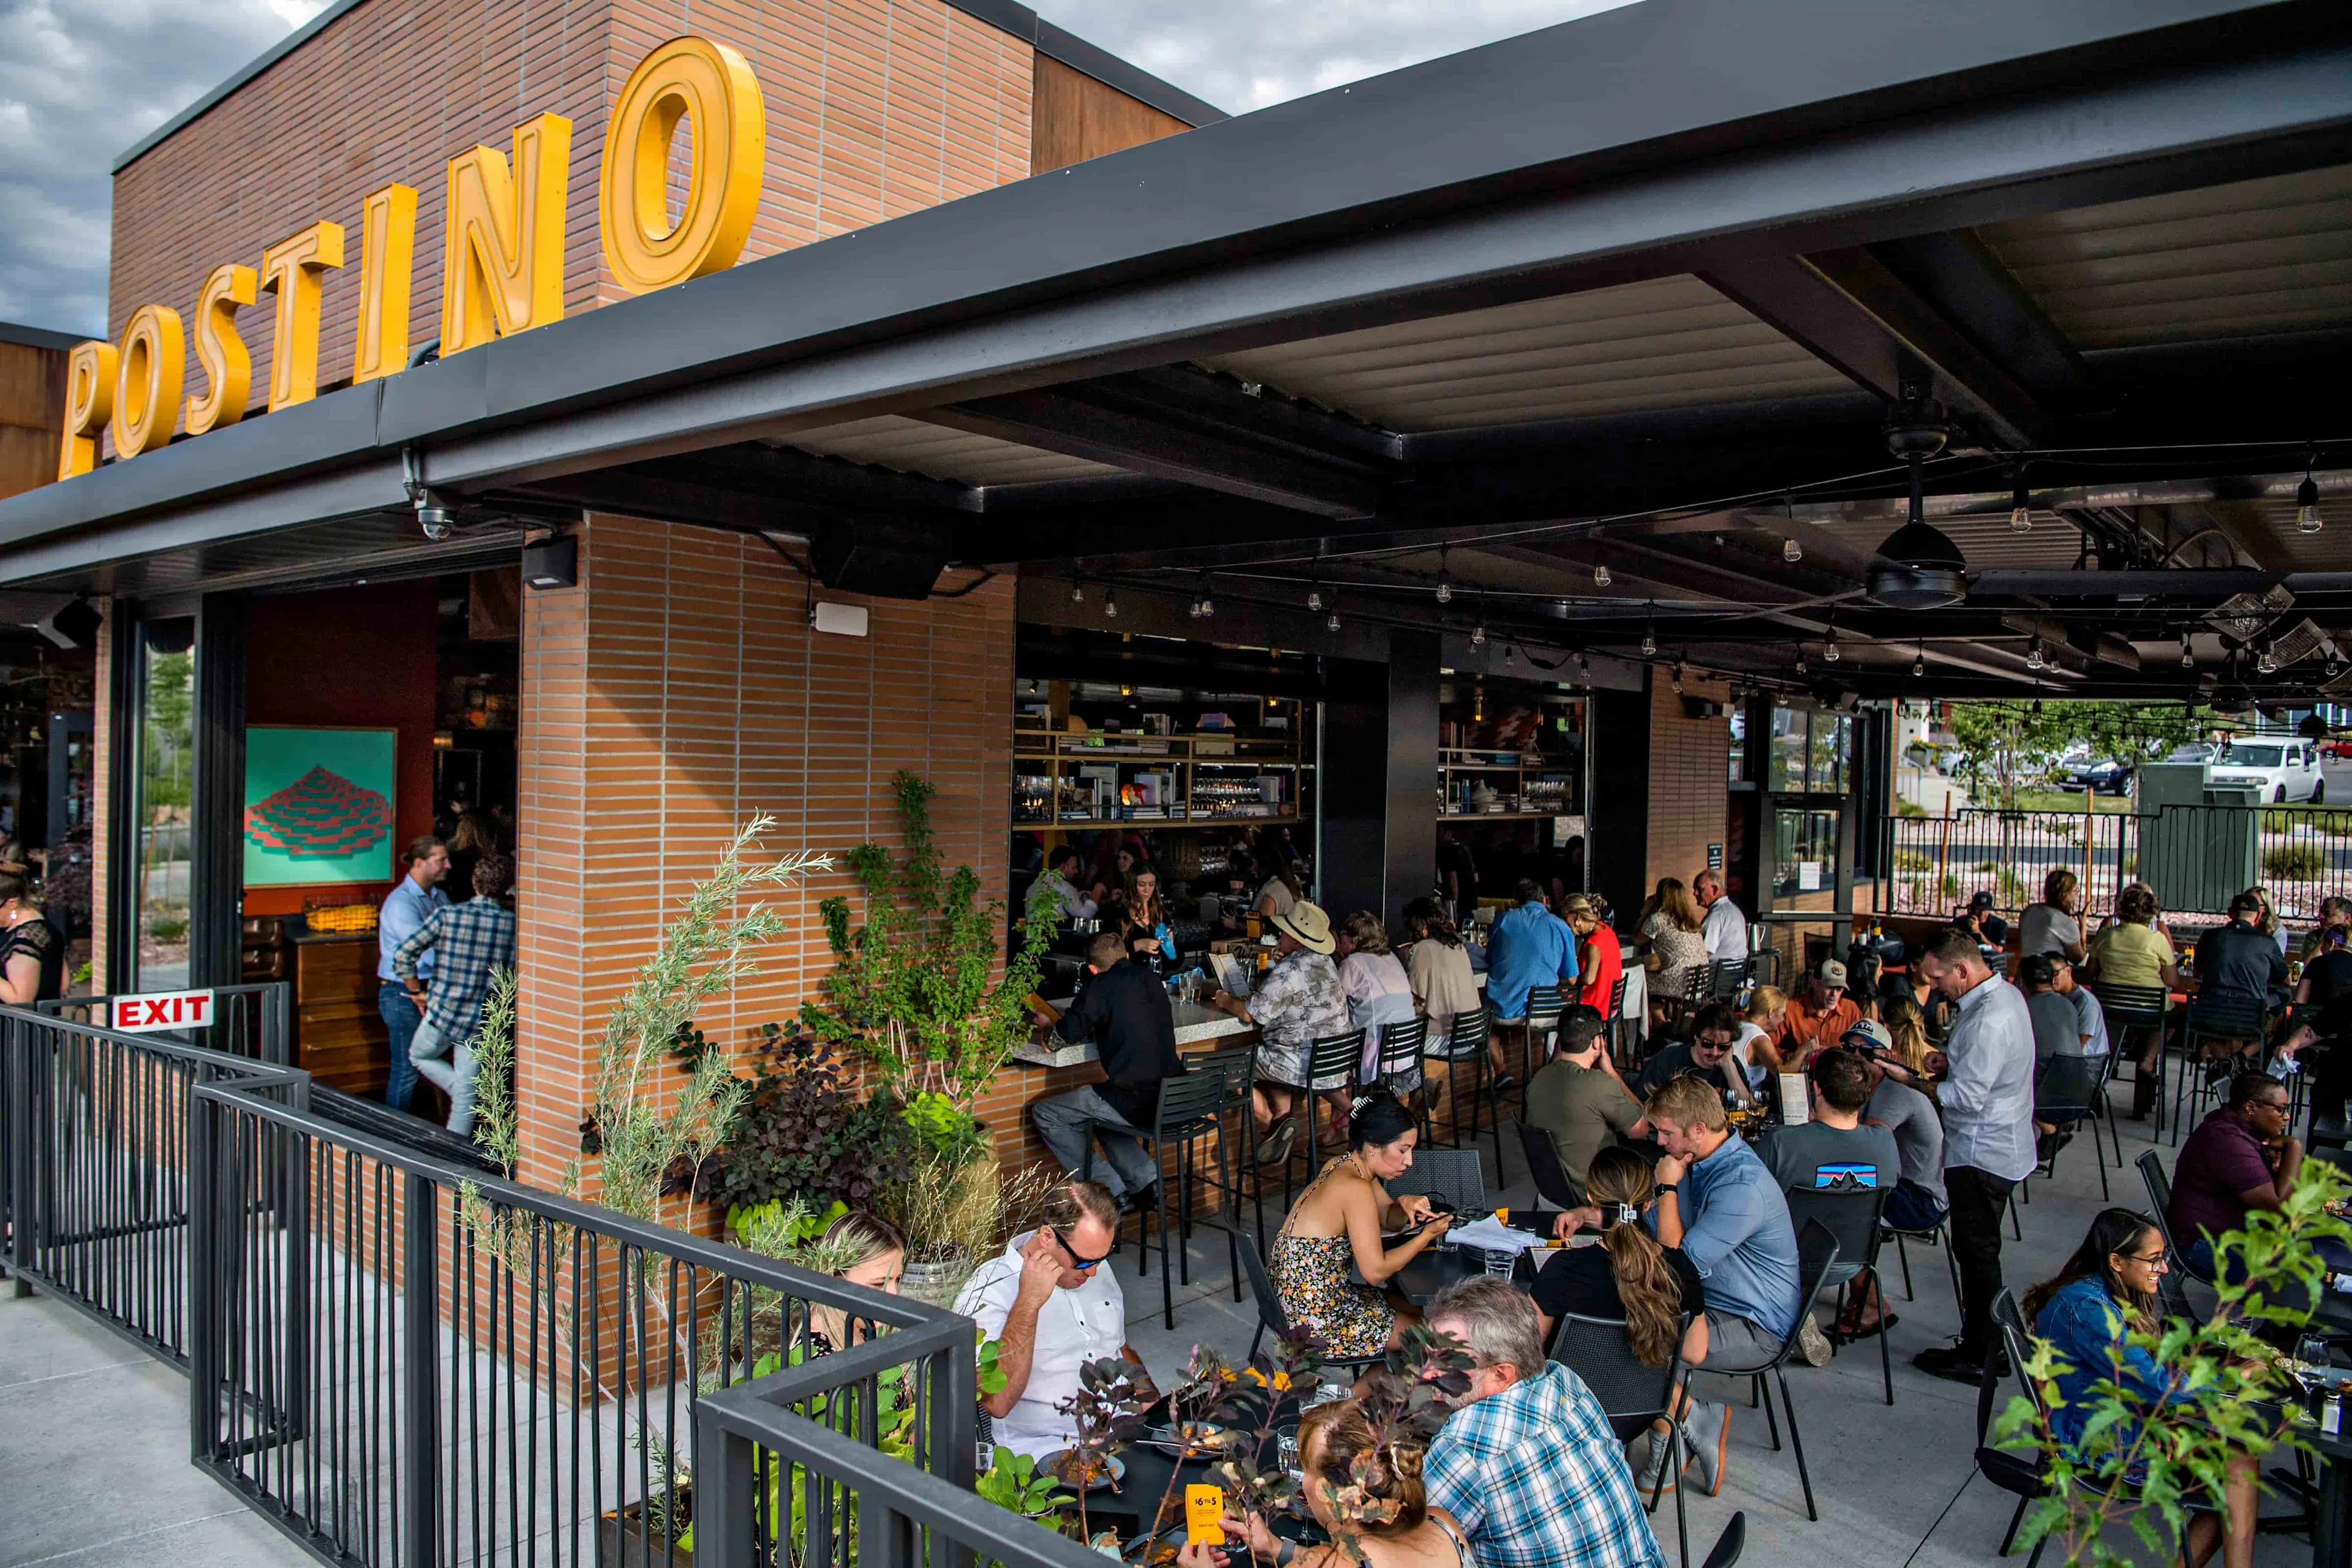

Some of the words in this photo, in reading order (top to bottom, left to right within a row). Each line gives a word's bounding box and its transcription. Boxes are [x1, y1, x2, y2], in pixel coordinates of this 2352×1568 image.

[59, 35, 766, 481] POSTINO
[119, 996, 209, 1027] EXIT
[1195, 1497, 1203, 1506] $6
[1212, 1497, 1216, 1506] 5
